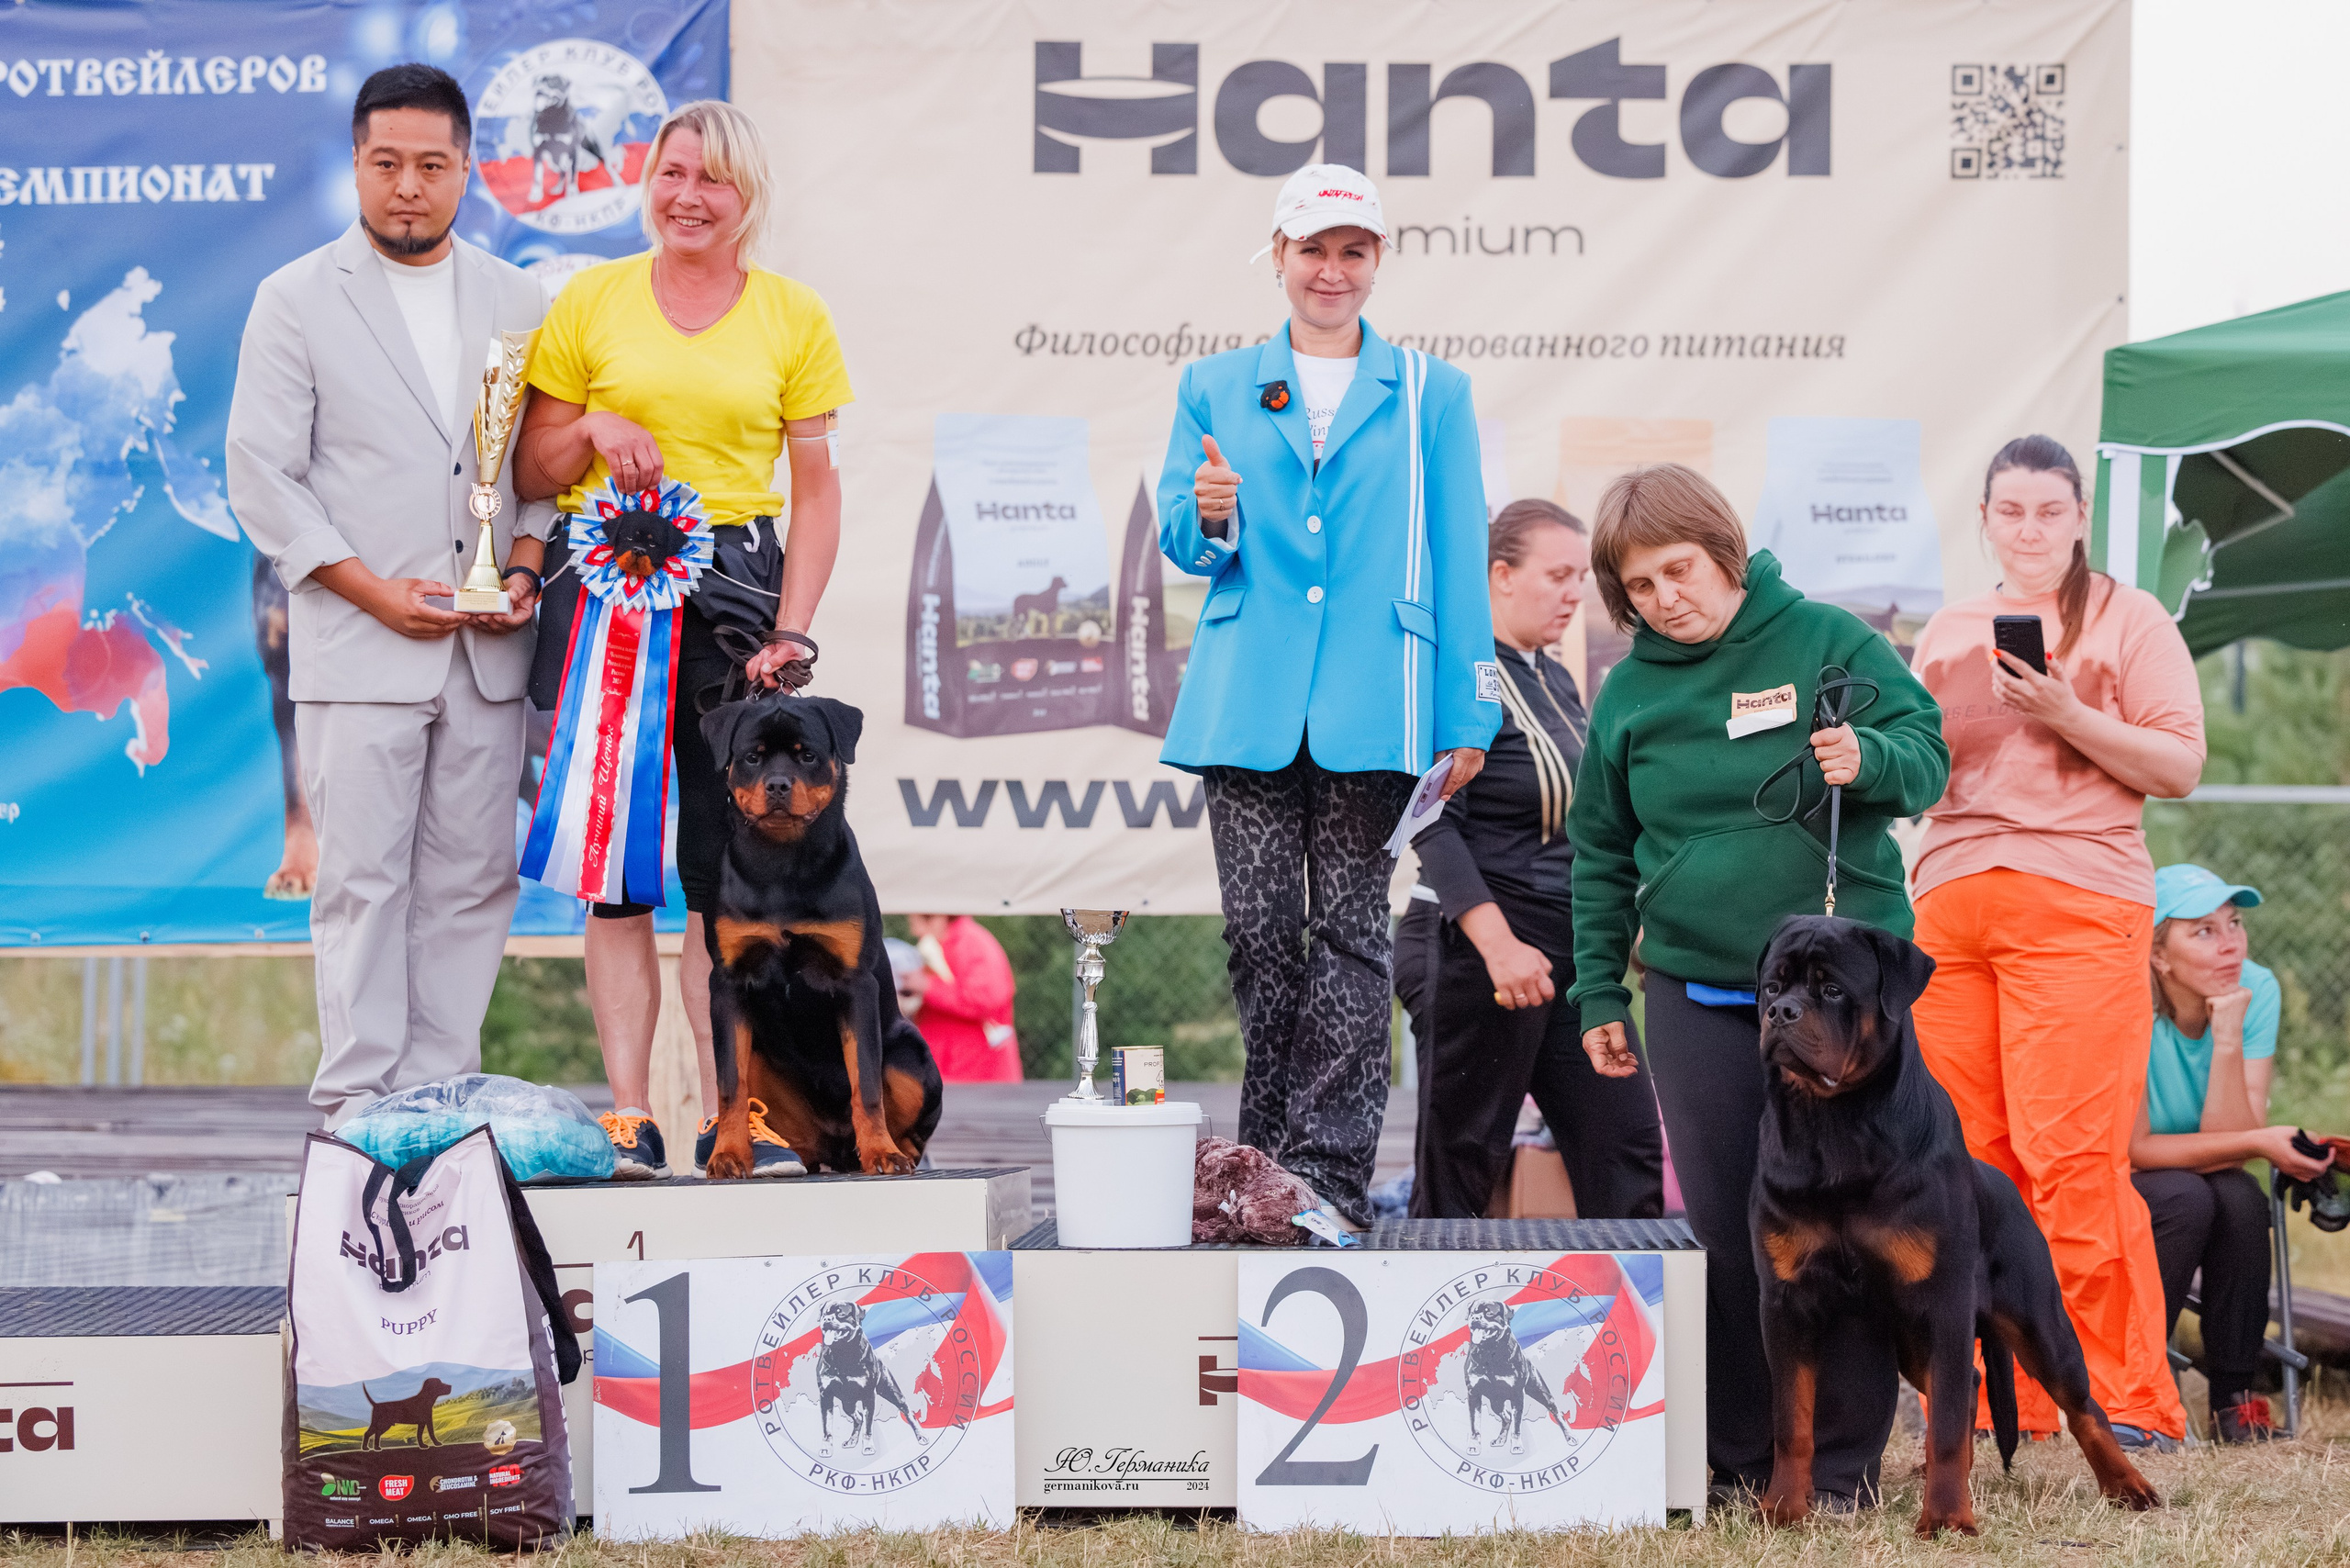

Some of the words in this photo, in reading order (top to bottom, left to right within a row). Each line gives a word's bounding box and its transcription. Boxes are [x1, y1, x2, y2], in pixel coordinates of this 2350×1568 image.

[0, 49, 327, 98] ОТВЕЙЛЕРОВ
[1034, 36, 1832, 178] Hanta
[1396, 215, 1584, 256] mium
[1660, 332, 1846, 358] питания
[975, 501, 1078, 521] Hanta
[1809, 503, 1908, 522] Hanta
[1736, 691, 1792, 710] Hanta
[598, 724, 615, 785] Щенок
[381, 1308, 438, 1336] PUPPY
[755, 1272, 840, 1436] РОТВЕЙЛЕР
[858, 1268, 934, 1303] КЛУБ
[940, 1308, 978, 1431] РОССИИ
[1402, 1272, 1489, 1432] РОТВЕЙЛЕР
[1506, 1268, 1584, 1304] КЛУБ
[1589, 1310, 1627, 1433] РОССИИ
[623, 1271, 722, 1495] 1
[1256, 1266, 1380, 1486] 2
[385, 1479, 408, 1488] FRESH
[809, 1455, 931, 1491] РКФ-НКПР
[1456, 1455, 1580, 1490] РКФ-НКПР
[386, 1487, 405, 1496] MEAT
[407, 1515, 432, 1523] OMEGA
[443, 1512, 461, 1520] GMO
[461, 1510, 478, 1518] FREE
[504, 1505, 521, 1513] FREE
